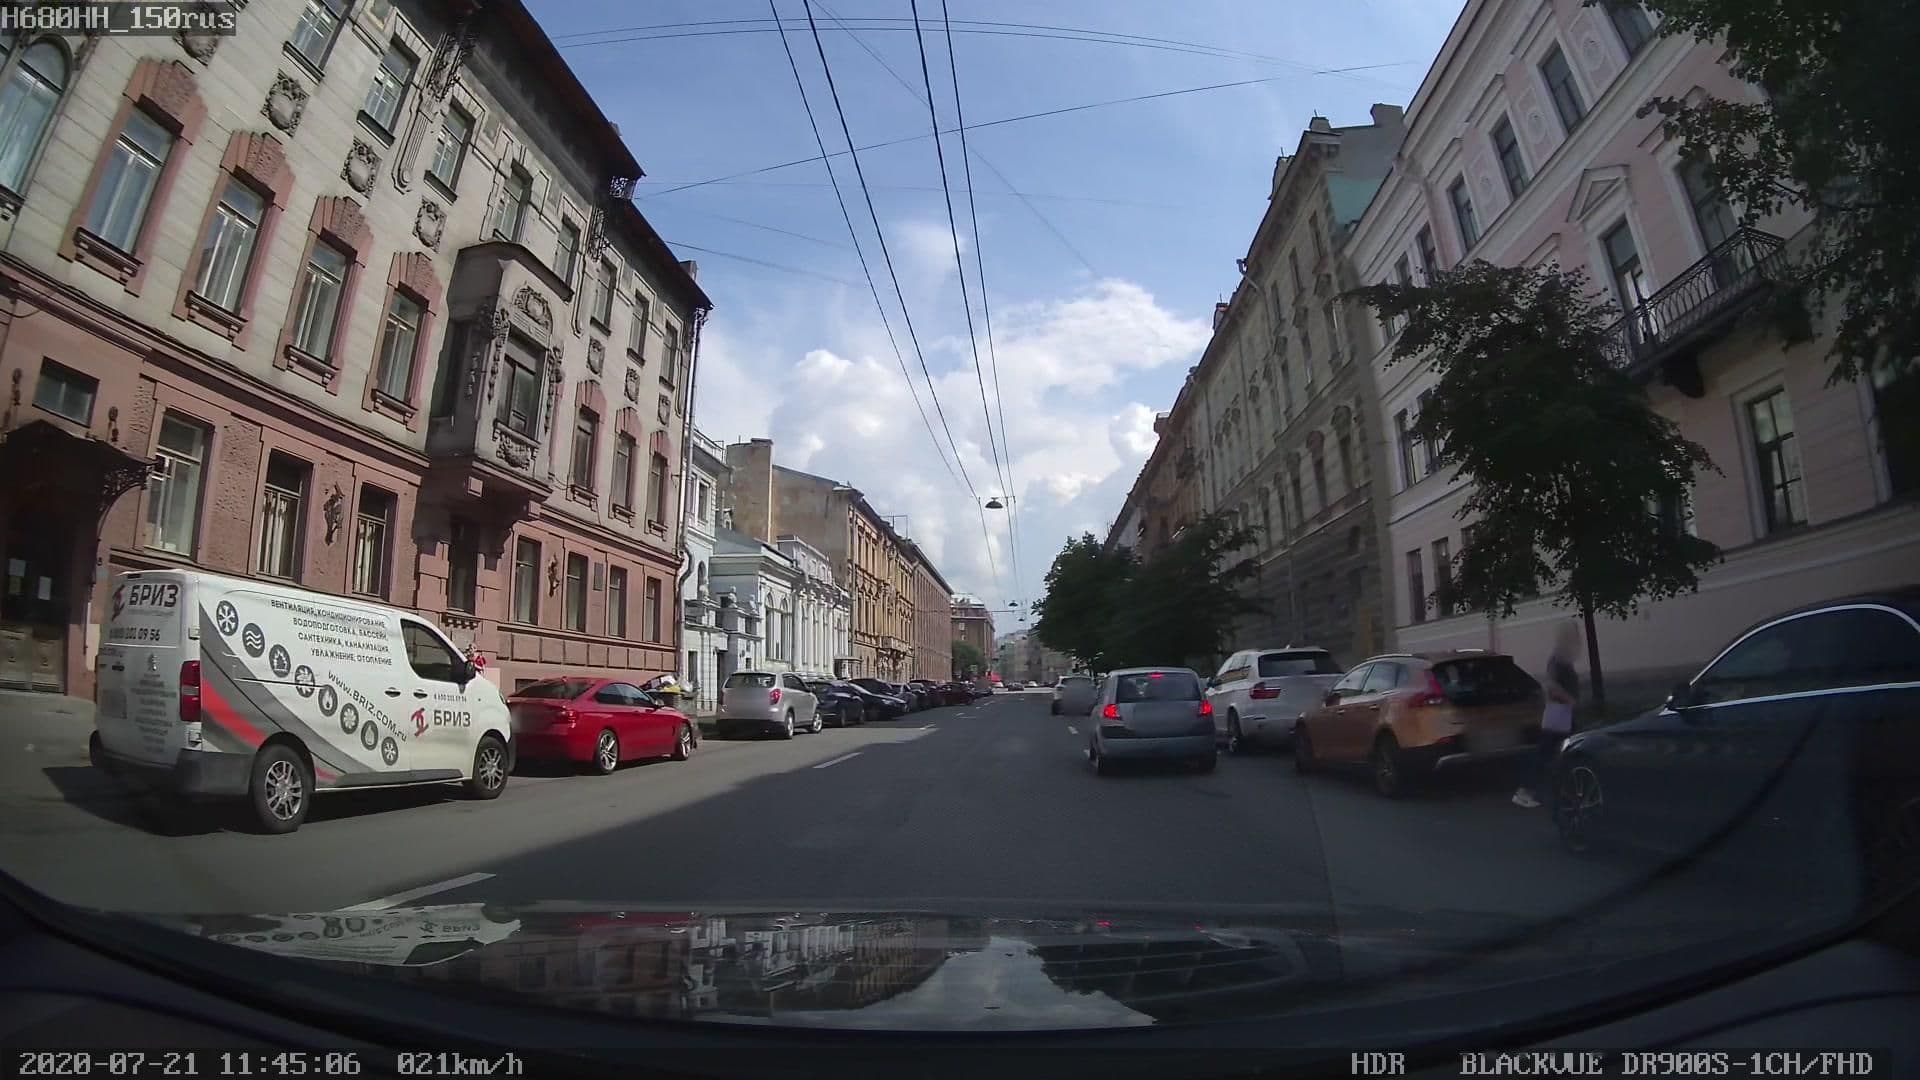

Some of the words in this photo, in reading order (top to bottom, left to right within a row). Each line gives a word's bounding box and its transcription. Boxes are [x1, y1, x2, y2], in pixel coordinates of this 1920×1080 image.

[129, 584, 179, 608] БРИЗ
[328, 670, 408, 743] www.BRIZ.COM.ru
[433, 709, 471, 728] БРИЗ
